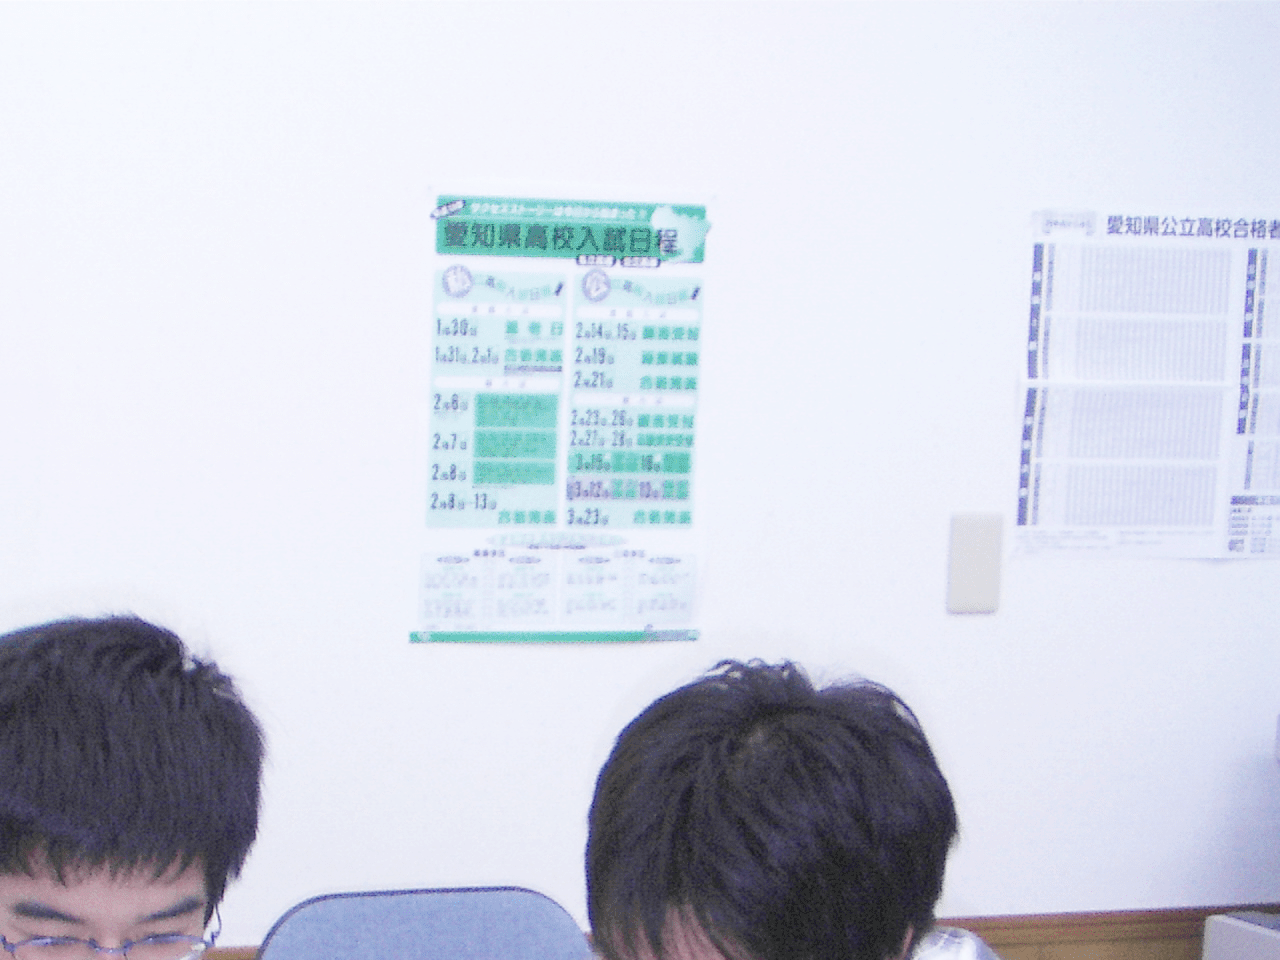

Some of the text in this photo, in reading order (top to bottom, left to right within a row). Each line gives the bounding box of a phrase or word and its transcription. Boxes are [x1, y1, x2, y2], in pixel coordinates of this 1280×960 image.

[444, 221, 678, 256] 愛知県高校入試日程
